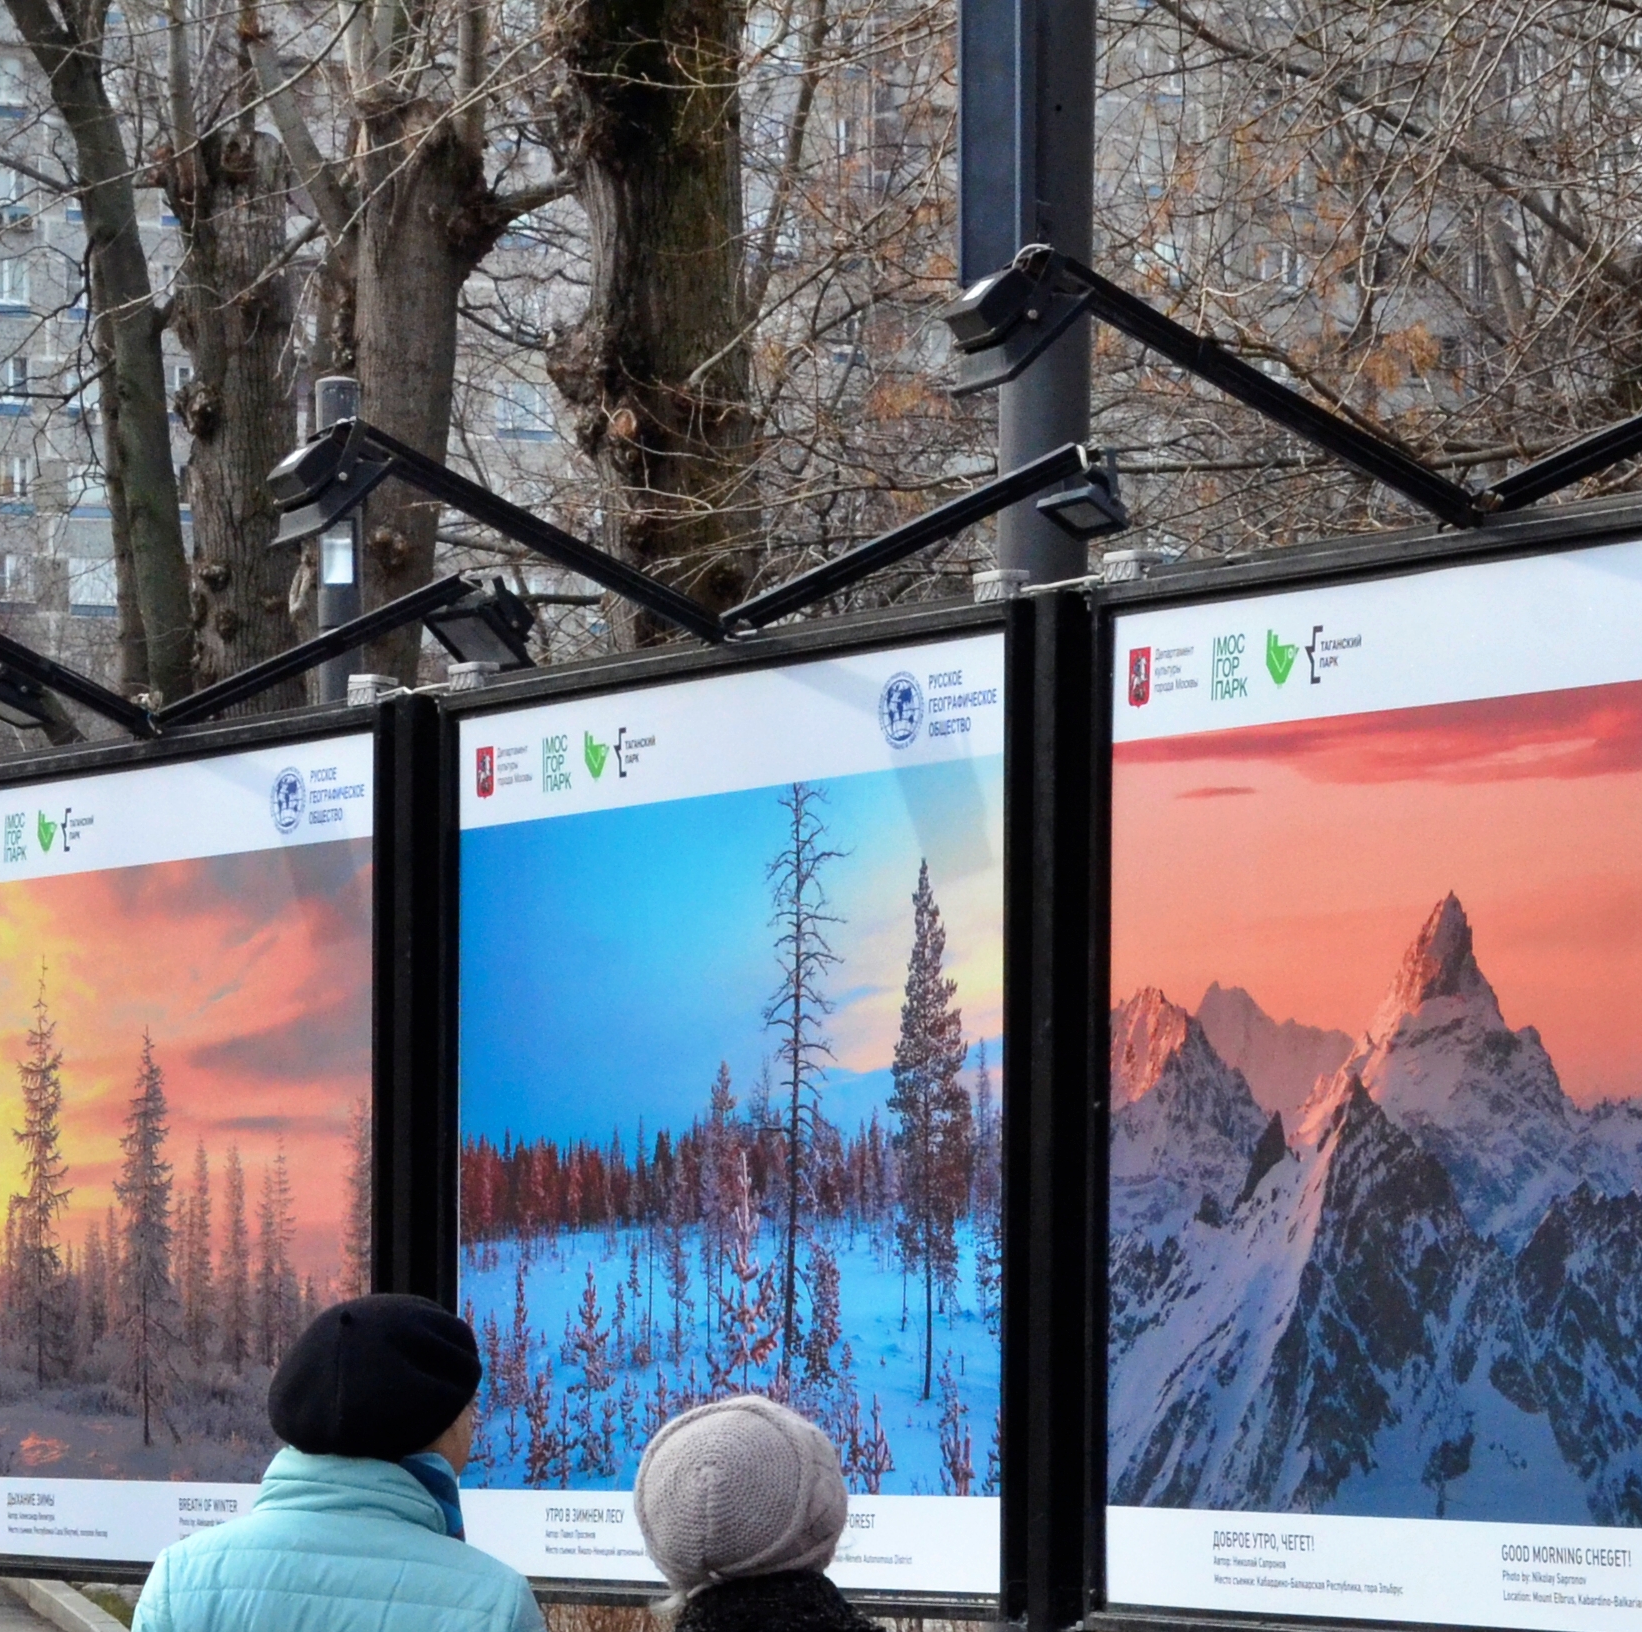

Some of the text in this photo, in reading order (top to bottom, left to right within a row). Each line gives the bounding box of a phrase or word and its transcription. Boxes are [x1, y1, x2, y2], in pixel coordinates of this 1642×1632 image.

[1216, 633, 1245, 655] МОС
[1320, 634, 1362, 652] ТАГАНСКИЙ
[1215, 656, 1240, 679] ГОР
[1319, 656, 1339, 669] ПАРК
[1214, 678, 1248, 701] ПАРК
[545, 734, 568, 754] МОС
[545, 754, 565, 774] ГОР
[545, 773, 573, 793] ПАРК
[178, 1497, 238, 1513] BREATH OF WINTER
[545, 1508, 625, 1523] УТРО В ЗИМНЕМ ЛЕСУ
[1213, 1530, 1315, 1552] ДОБРОЕ УТРО, ЧЕГЕТ!
[1501, 1543, 1632, 1567] GOOD MORNING CHEGET!
